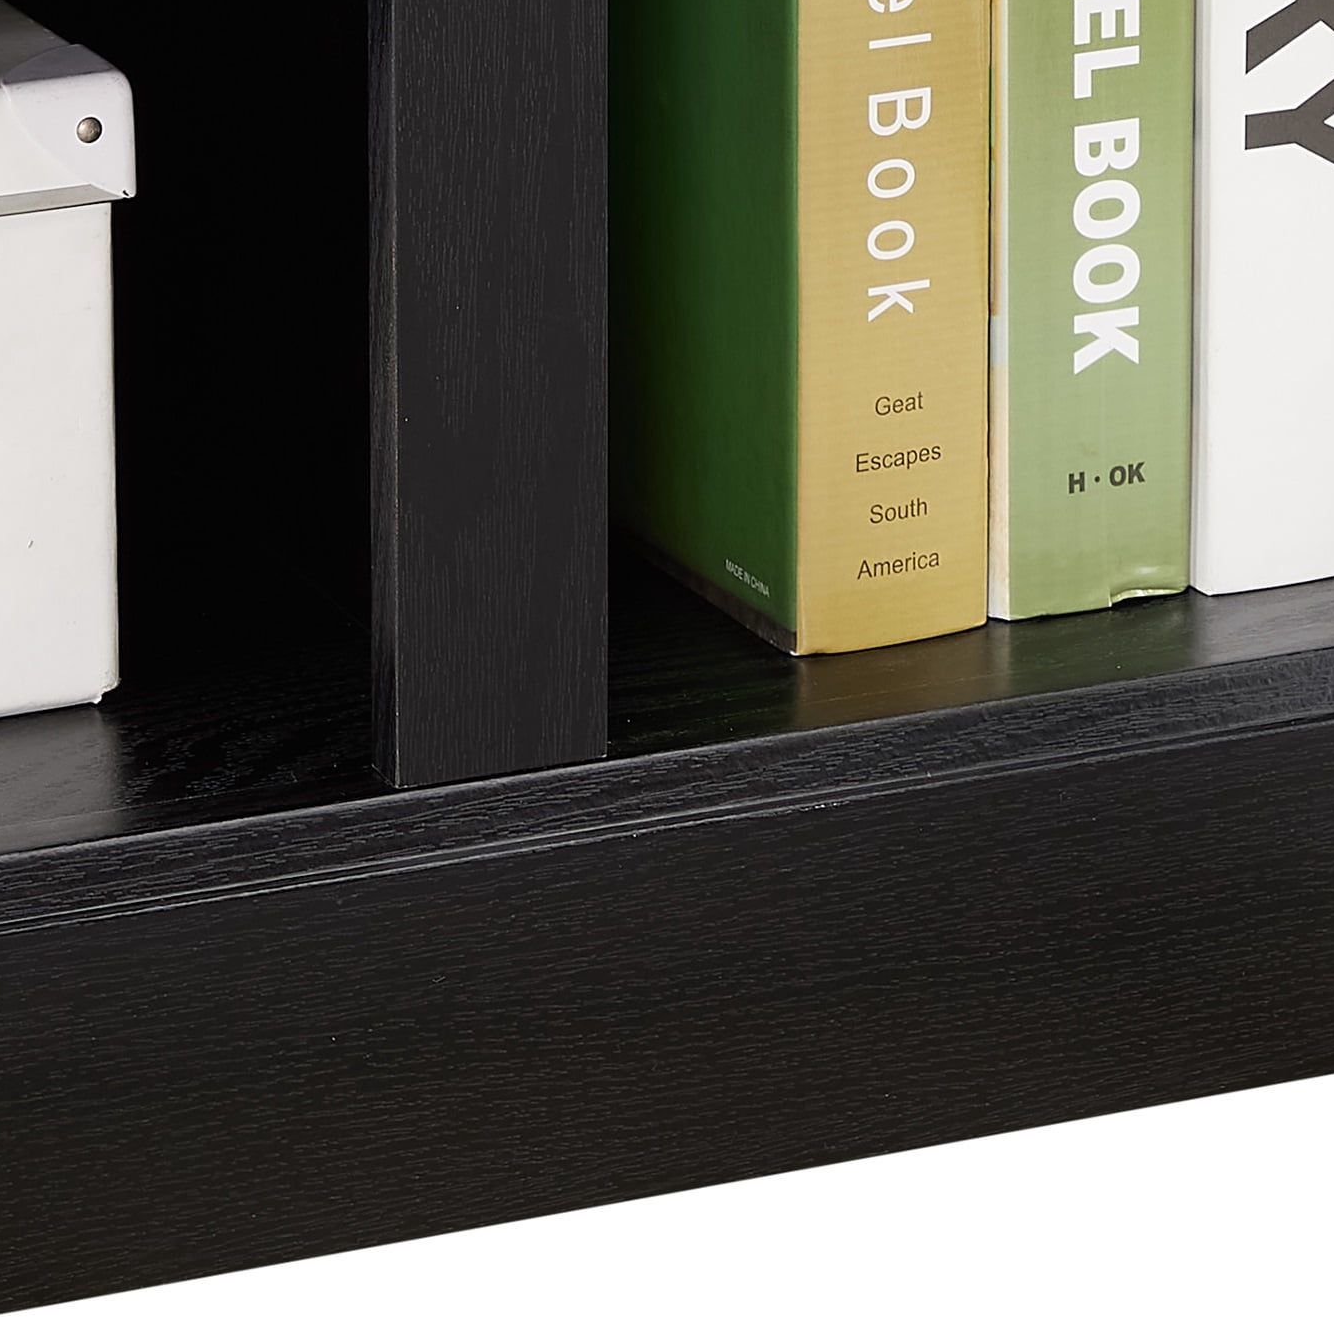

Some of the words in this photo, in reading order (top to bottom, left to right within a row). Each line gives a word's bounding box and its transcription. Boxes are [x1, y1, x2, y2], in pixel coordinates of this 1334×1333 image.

[867, 85, 932, 322] Book
[1072, 117, 1142, 375] BOOK
[874, 391, 924, 416] Geat
[855, 445, 942, 473] Escapes
[869, 498, 928, 525] South
[856, 551, 940, 580] America
